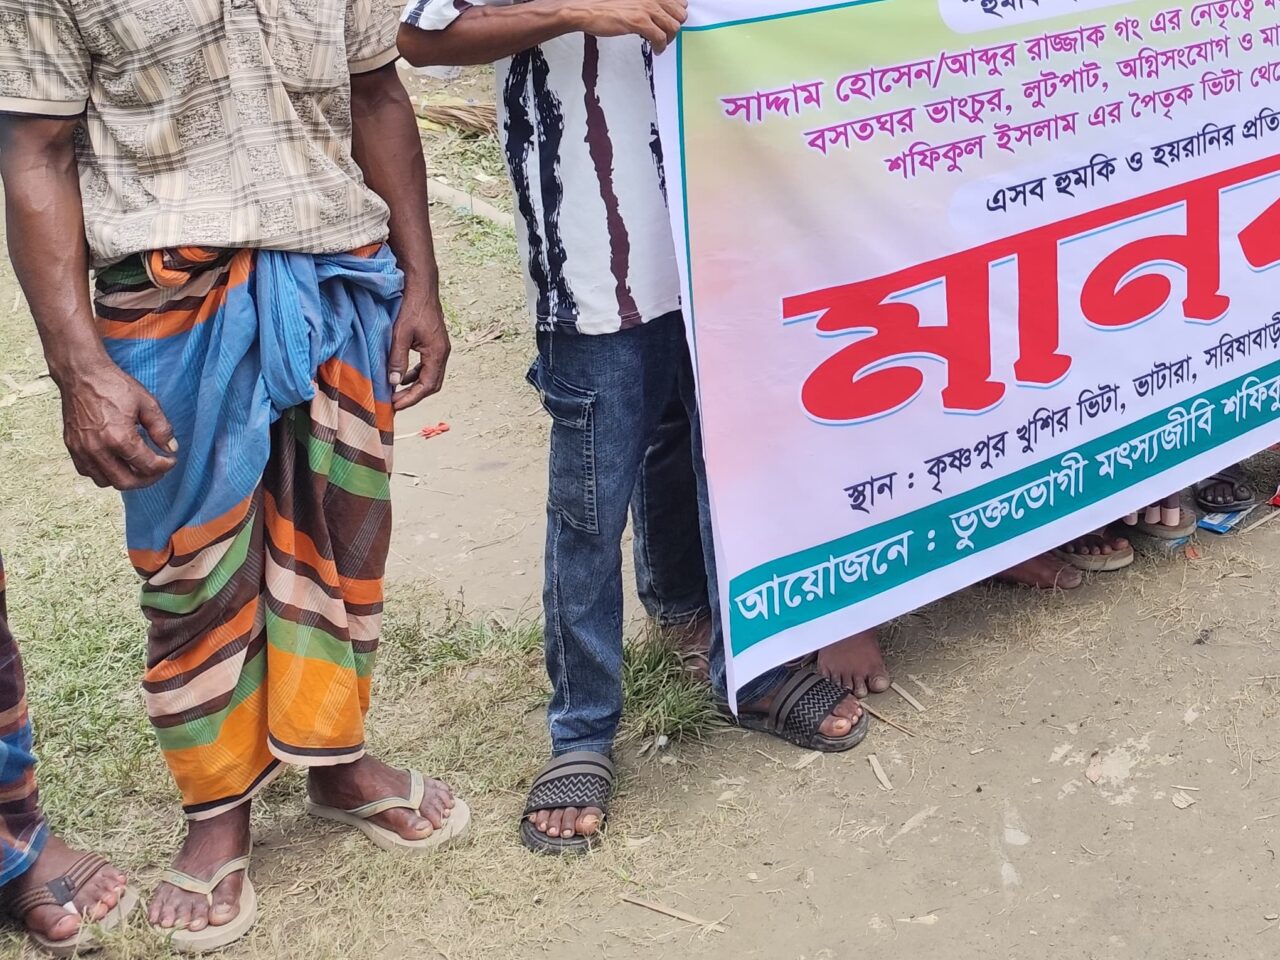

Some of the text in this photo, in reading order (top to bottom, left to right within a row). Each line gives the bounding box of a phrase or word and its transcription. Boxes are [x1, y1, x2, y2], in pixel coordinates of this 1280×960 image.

[720, 81, 824, 122] সাদ্দাম
[836, 42, 1018, 102] হোসেন/আব্দুর
[1024, 25, 1106, 62] রাজ্জাক
[1114, 16, 1143, 42] গং
[1150, 9, 1183, 33] এর
[803, 107, 916, 155] বসতঘর
[924, 88, 1012, 124] ভাংচুর,
[1022, 62, 1108, 108] লুটপাট,
[1116, 34, 1230, 80] অগ্নিসংযোগ
[1238, 33, 1253, 51] ও
[884, 135, 986, 179] শফিকুল
[994, 112, 1079, 153] ইসলাম
[1088, 101, 1124, 127] এর
[1129, 83, 1194, 120] পৈতৃক
[1200, 69, 1243, 100] ভিটা
[986, 177, 1047, 213] এসব
[1053, 153, 1117, 197] হুমকি
[1125, 152, 1143, 172] ও
[1151, 123, 1236, 167] হয়রানির
[843, 472, 898, 514] স্থান
[924, 431, 1009, 494] কৃষ্ণপুর
[1016, 406, 1071, 453] খুশির
[1076, 383, 1127, 426] ভিটা,
[1133, 354, 1197, 398] ভাটারা,
[734, 530, 915, 621] আয়োজনে
[949, 451, 1088, 550] ভুক্তভোগী
[1095, 398, 1215, 480] মৎস্যজীবি
